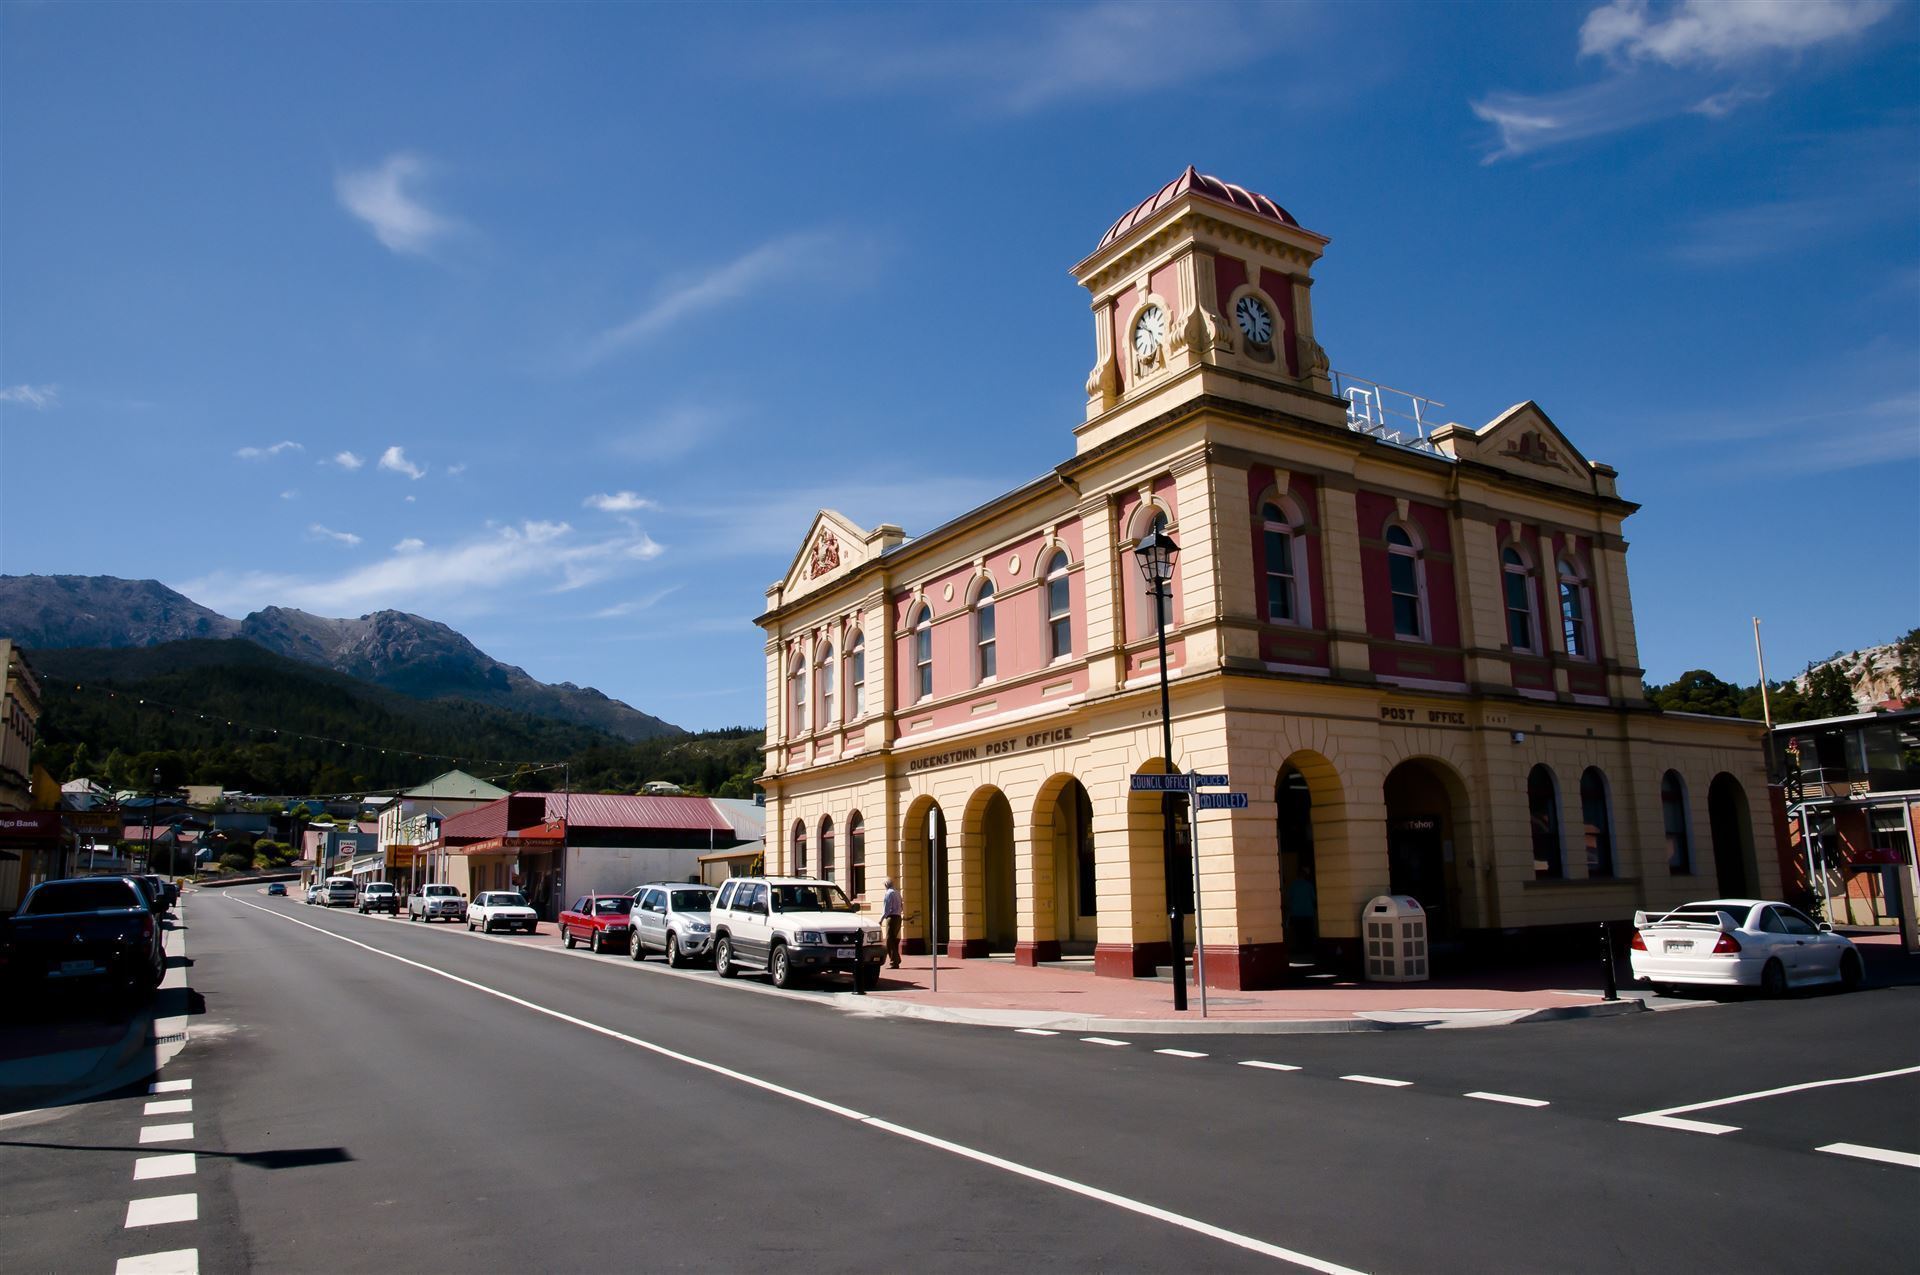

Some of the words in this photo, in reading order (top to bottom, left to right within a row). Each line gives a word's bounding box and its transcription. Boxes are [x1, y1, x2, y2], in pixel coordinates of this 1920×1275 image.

[1381, 707, 1415, 721] POST
[1428, 710, 1465, 724] OFFICE
[910, 747, 977, 771] QUEENSTOWN
[985, 739, 1017, 756] POST
[1026, 727, 1073, 747] OFFICE
[1131, 776, 1162, 789] COUNCIL
[1165, 776, 1189, 789] OFFICE
[1196, 775, 1221, 785] POLICE
[1211, 794, 1240, 807] TOILET
[16, 820, 39, 828] Bank
